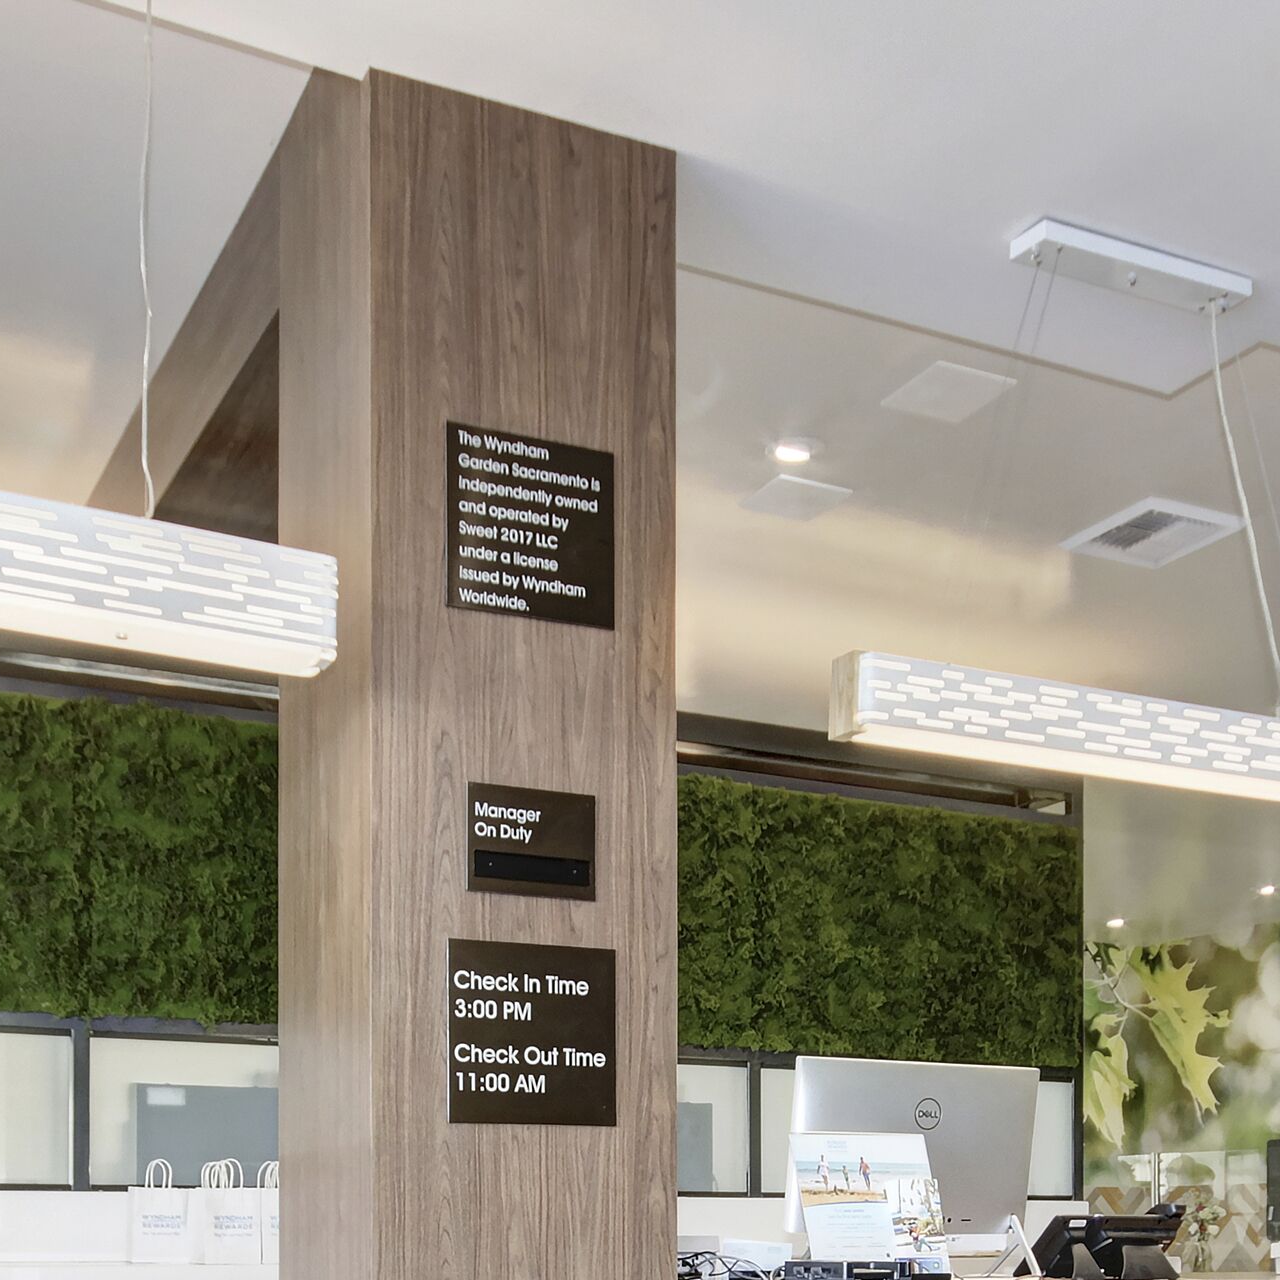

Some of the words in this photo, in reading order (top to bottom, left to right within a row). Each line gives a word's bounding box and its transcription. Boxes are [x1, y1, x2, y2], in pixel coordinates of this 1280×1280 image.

[458, 430, 482, 447] The
[484, 434, 549, 461] Wyndham
[458, 453, 509, 475] Garden
[512, 462, 589, 489] Sacramento
[458, 500, 486, 516] and
[489, 505, 549, 526] operated
[552, 514, 569, 532] by
[555, 494, 598, 513] owned
[459, 520, 497, 540] Sweet
[501, 528, 533, 545] 2017
[536, 533, 559, 549] LLC
[459, 544, 497, 562] under
[501, 552, 510, 563] a
[513, 552, 558, 572] license
[503, 571, 519, 589] by
[522, 575, 586, 598] Wyndham
[458, 588, 530, 611] Worldwide.
[474, 801, 541, 824] Manager
[474, 822, 497, 838] On
[501, 824, 532, 843] Duty
[453, 969, 519, 993] Check
[524, 974, 541, 994] In
[545, 975, 589, 996] Time
[454, 999, 498, 1020] 3:00
[503, 1002, 532, 1021] PM
[453, 1043, 519, 1065] Check
[524, 1046, 559, 1066] Out
[563, 1047, 606, 1068] Time
[455, 1072, 510, 1092] 11:00
[514, 1074, 546, 1093] AM
[918, 1110, 939, 1119] DELL
